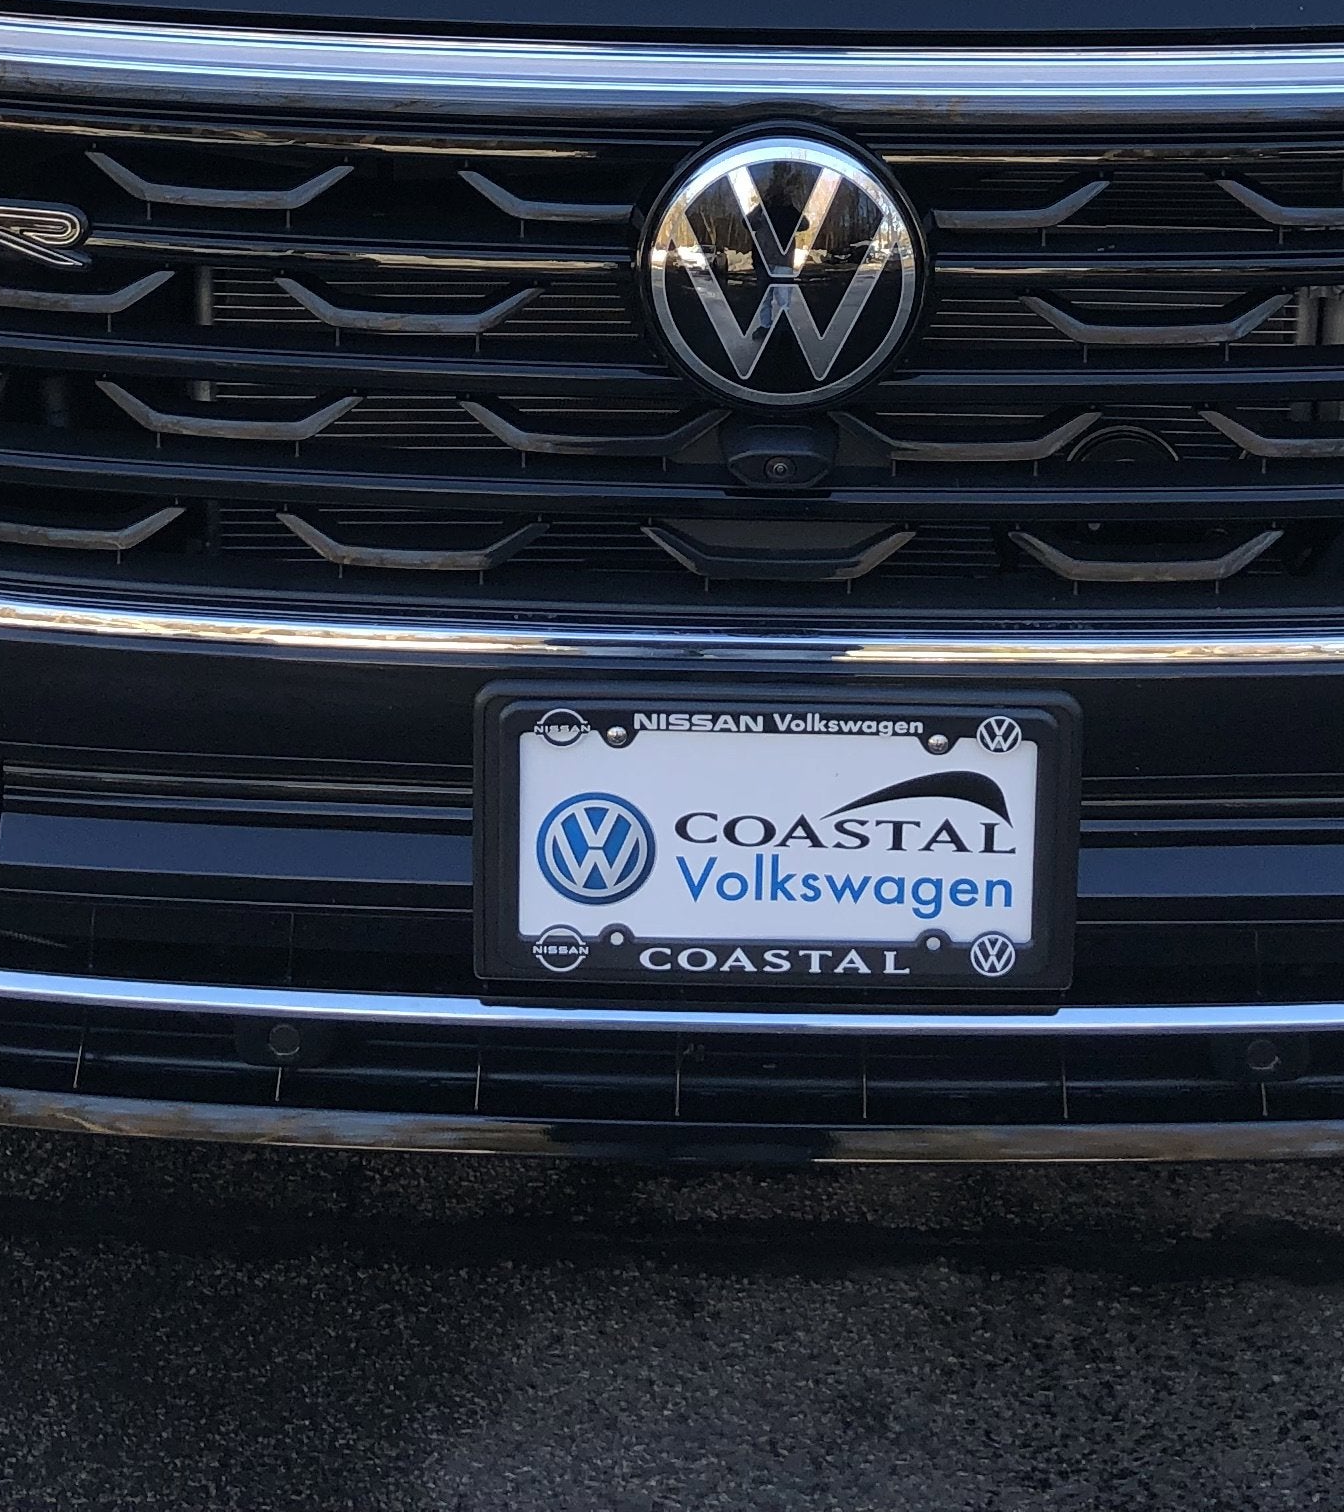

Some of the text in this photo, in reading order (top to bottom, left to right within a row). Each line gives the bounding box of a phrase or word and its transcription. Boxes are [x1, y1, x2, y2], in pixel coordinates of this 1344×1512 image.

[533, 723, 591, 734] NISSAN
[633, 713, 924, 737] NISSAN Volkswagen
[674, 812, 1017, 855] COASTAL
[675, 853, 1014, 919] Volkswagen
[532, 945, 589, 955] NISSAN
[639, 946, 910, 974] COASTAL
